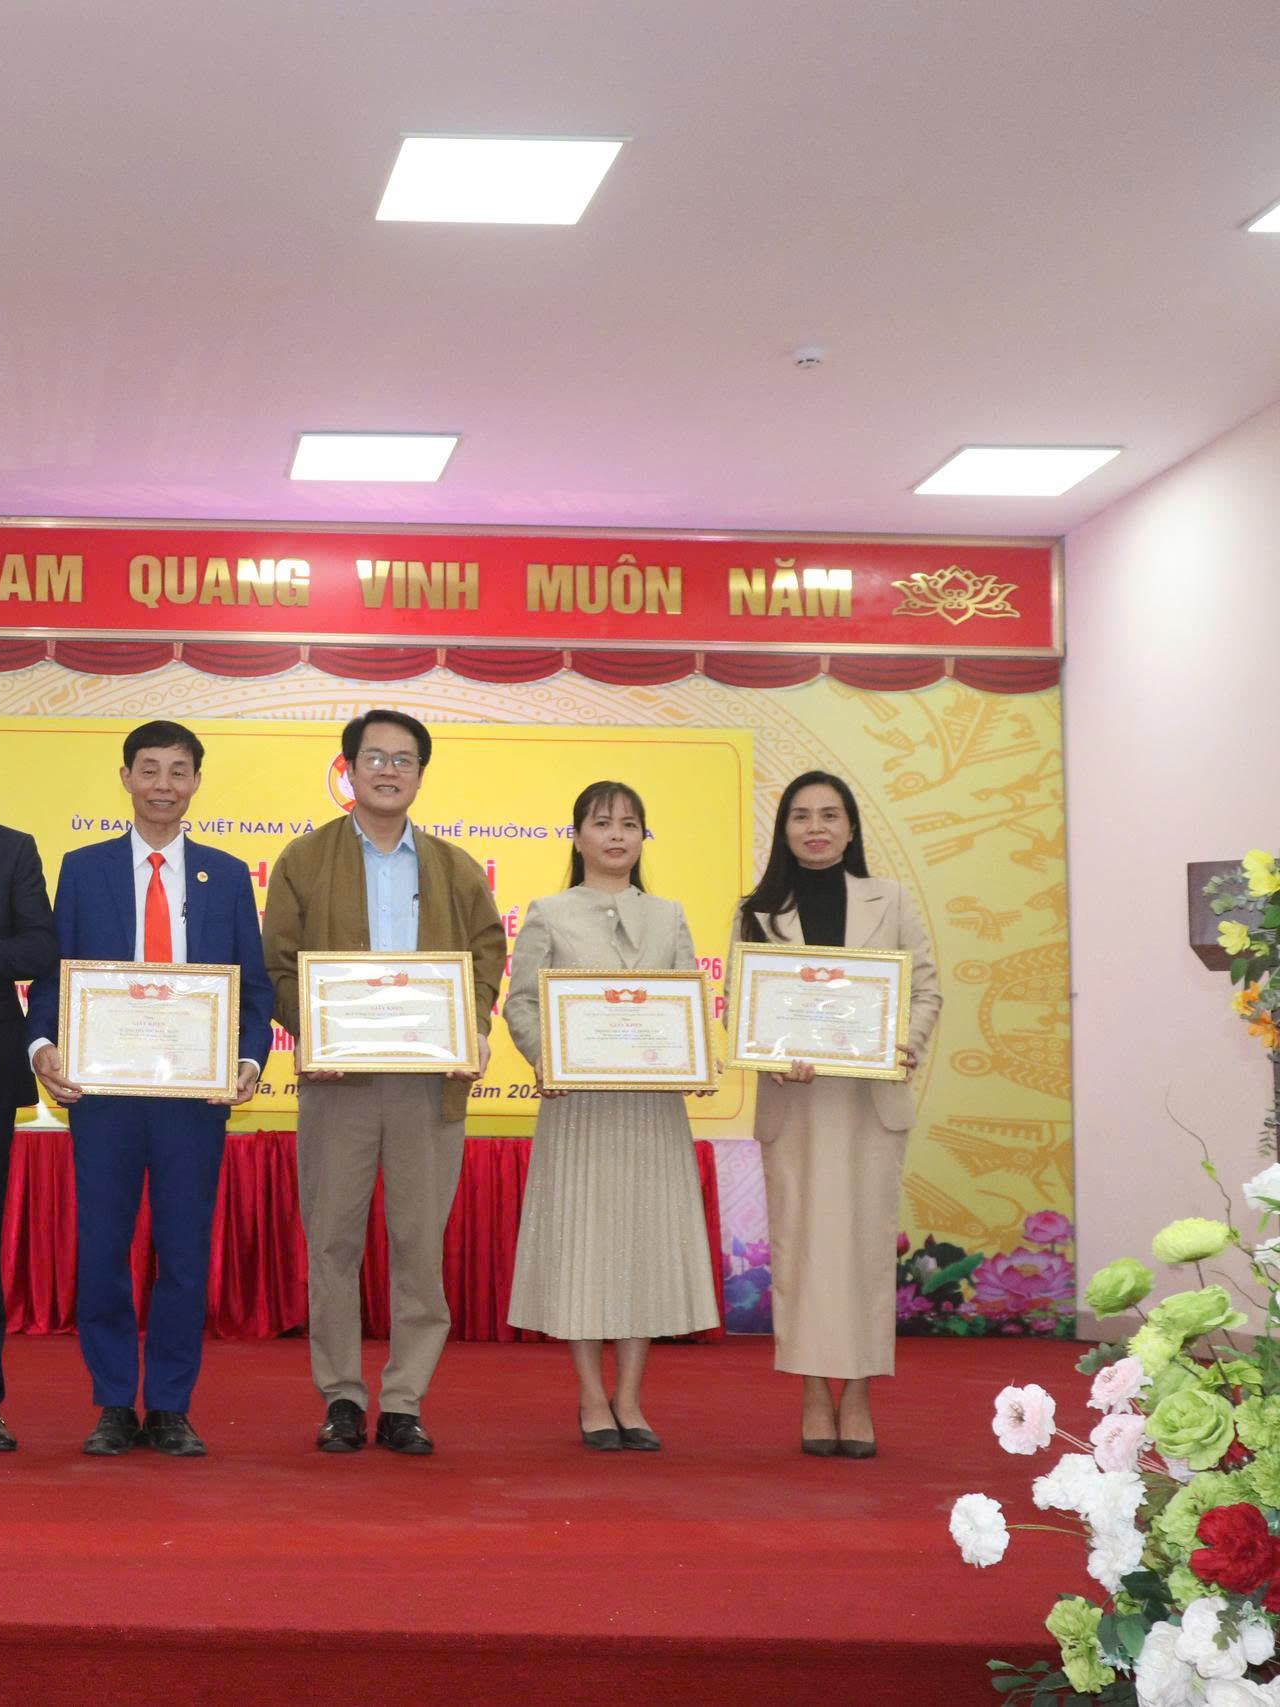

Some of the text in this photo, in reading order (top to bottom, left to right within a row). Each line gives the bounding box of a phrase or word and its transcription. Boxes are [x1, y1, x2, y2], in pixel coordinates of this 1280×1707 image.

[129, 555, 310, 609] QUANG
[356, 559, 479, 610] VINH
[526, 553, 682, 615] MUÔN
[728, 557, 852, 617] NĂM
[71, 814, 94, 831] ỦY
[198, 818, 234, 836] VIỆT
[239, 821, 284, 834] NAM
[289, 819, 316, 835] VÀ
[433, 818, 464, 838] THỂ
[468, 822, 549, 839] PHƯỜNG
